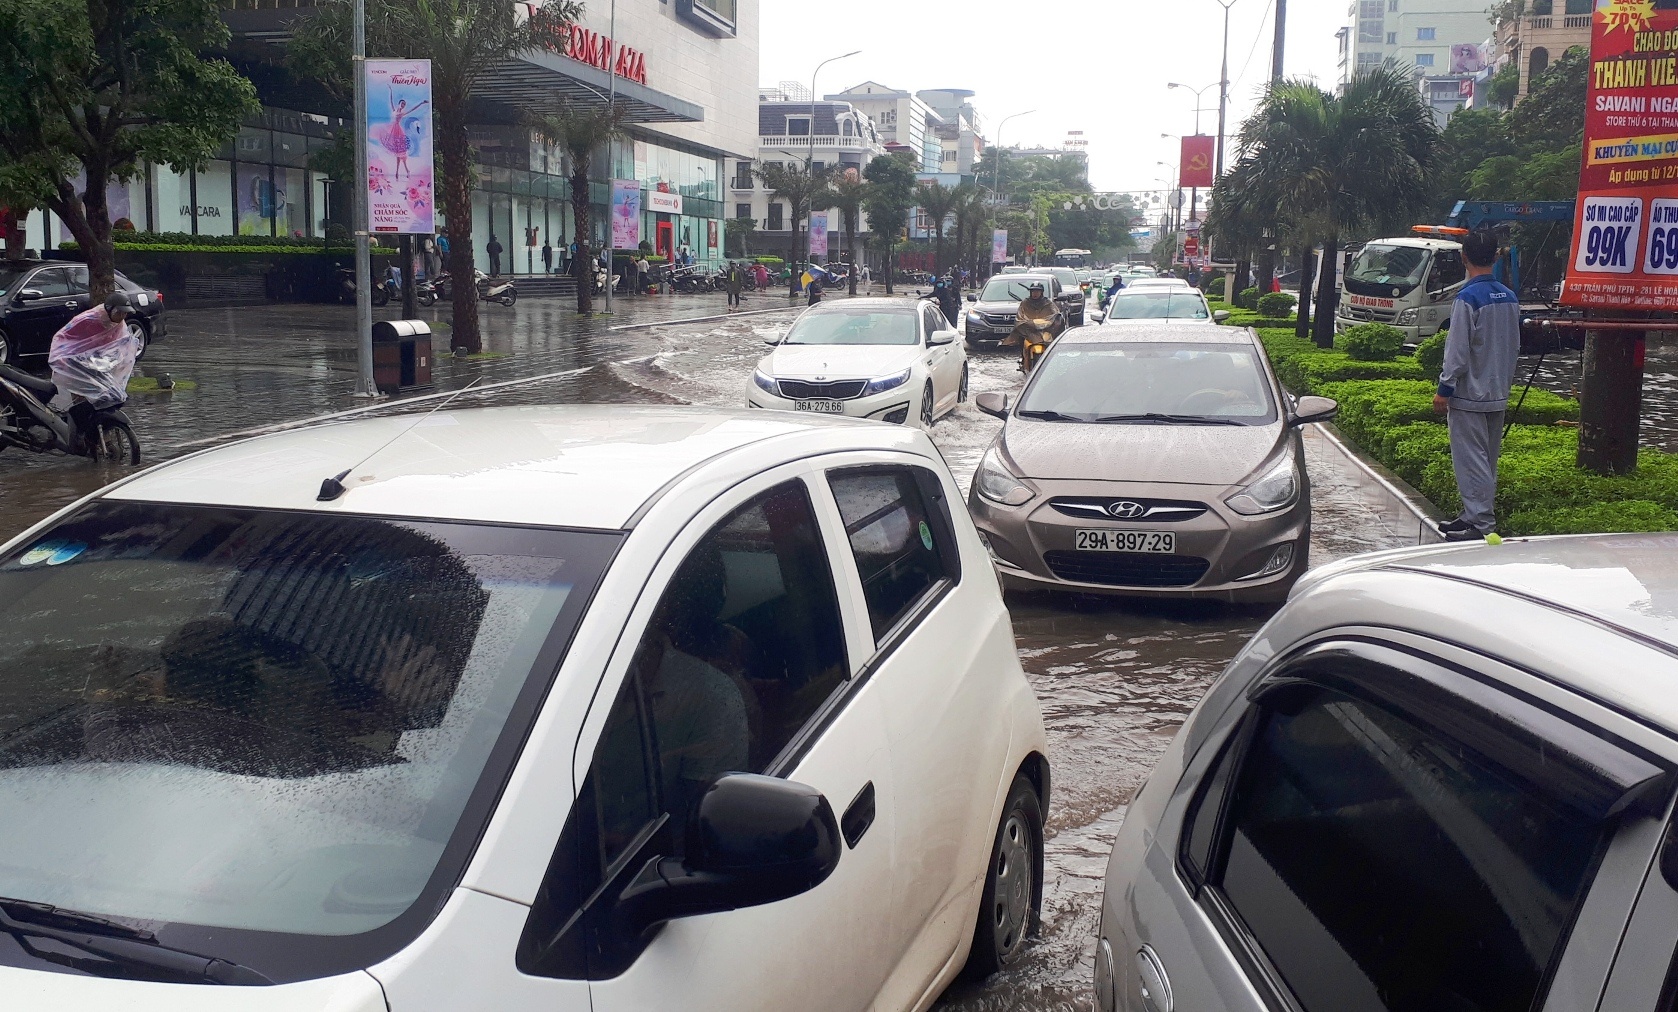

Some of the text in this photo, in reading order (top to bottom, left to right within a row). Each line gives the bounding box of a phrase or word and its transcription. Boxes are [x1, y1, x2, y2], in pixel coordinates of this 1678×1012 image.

[1609, 12, 1645, 26] 70%
[1594, 51, 1678, 89] THÀNH VIÊ
[1595, 96, 1645, 112] SAVANI
[1606, 116, 1626, 126] STORE
[1642, 118, 1647, 127] 6
[1648, 117, 1659, 130] TẠI
[1594, 139, 1639, 159] KHUYẾN
[1641, 142, 1662, 158] MẠI
[1609, 167, 1621, 183] Áp
[1624, 169, 1649, 184] dụng
[1586, 201, 1639, 222] SƠ MI CAO CẤP
[1653, 203, 1662, 222] ÁO
[1585, 225, 1632, 267] 99K
[1650, 227, 1678, 269] 69
[1618, 286, 1635, 294] TPTH
[1640, 286, 1652, 294] 281
[1366, 298, 1377, 306] GIAO
[796, 401, 842, 411] 36A-279.66
